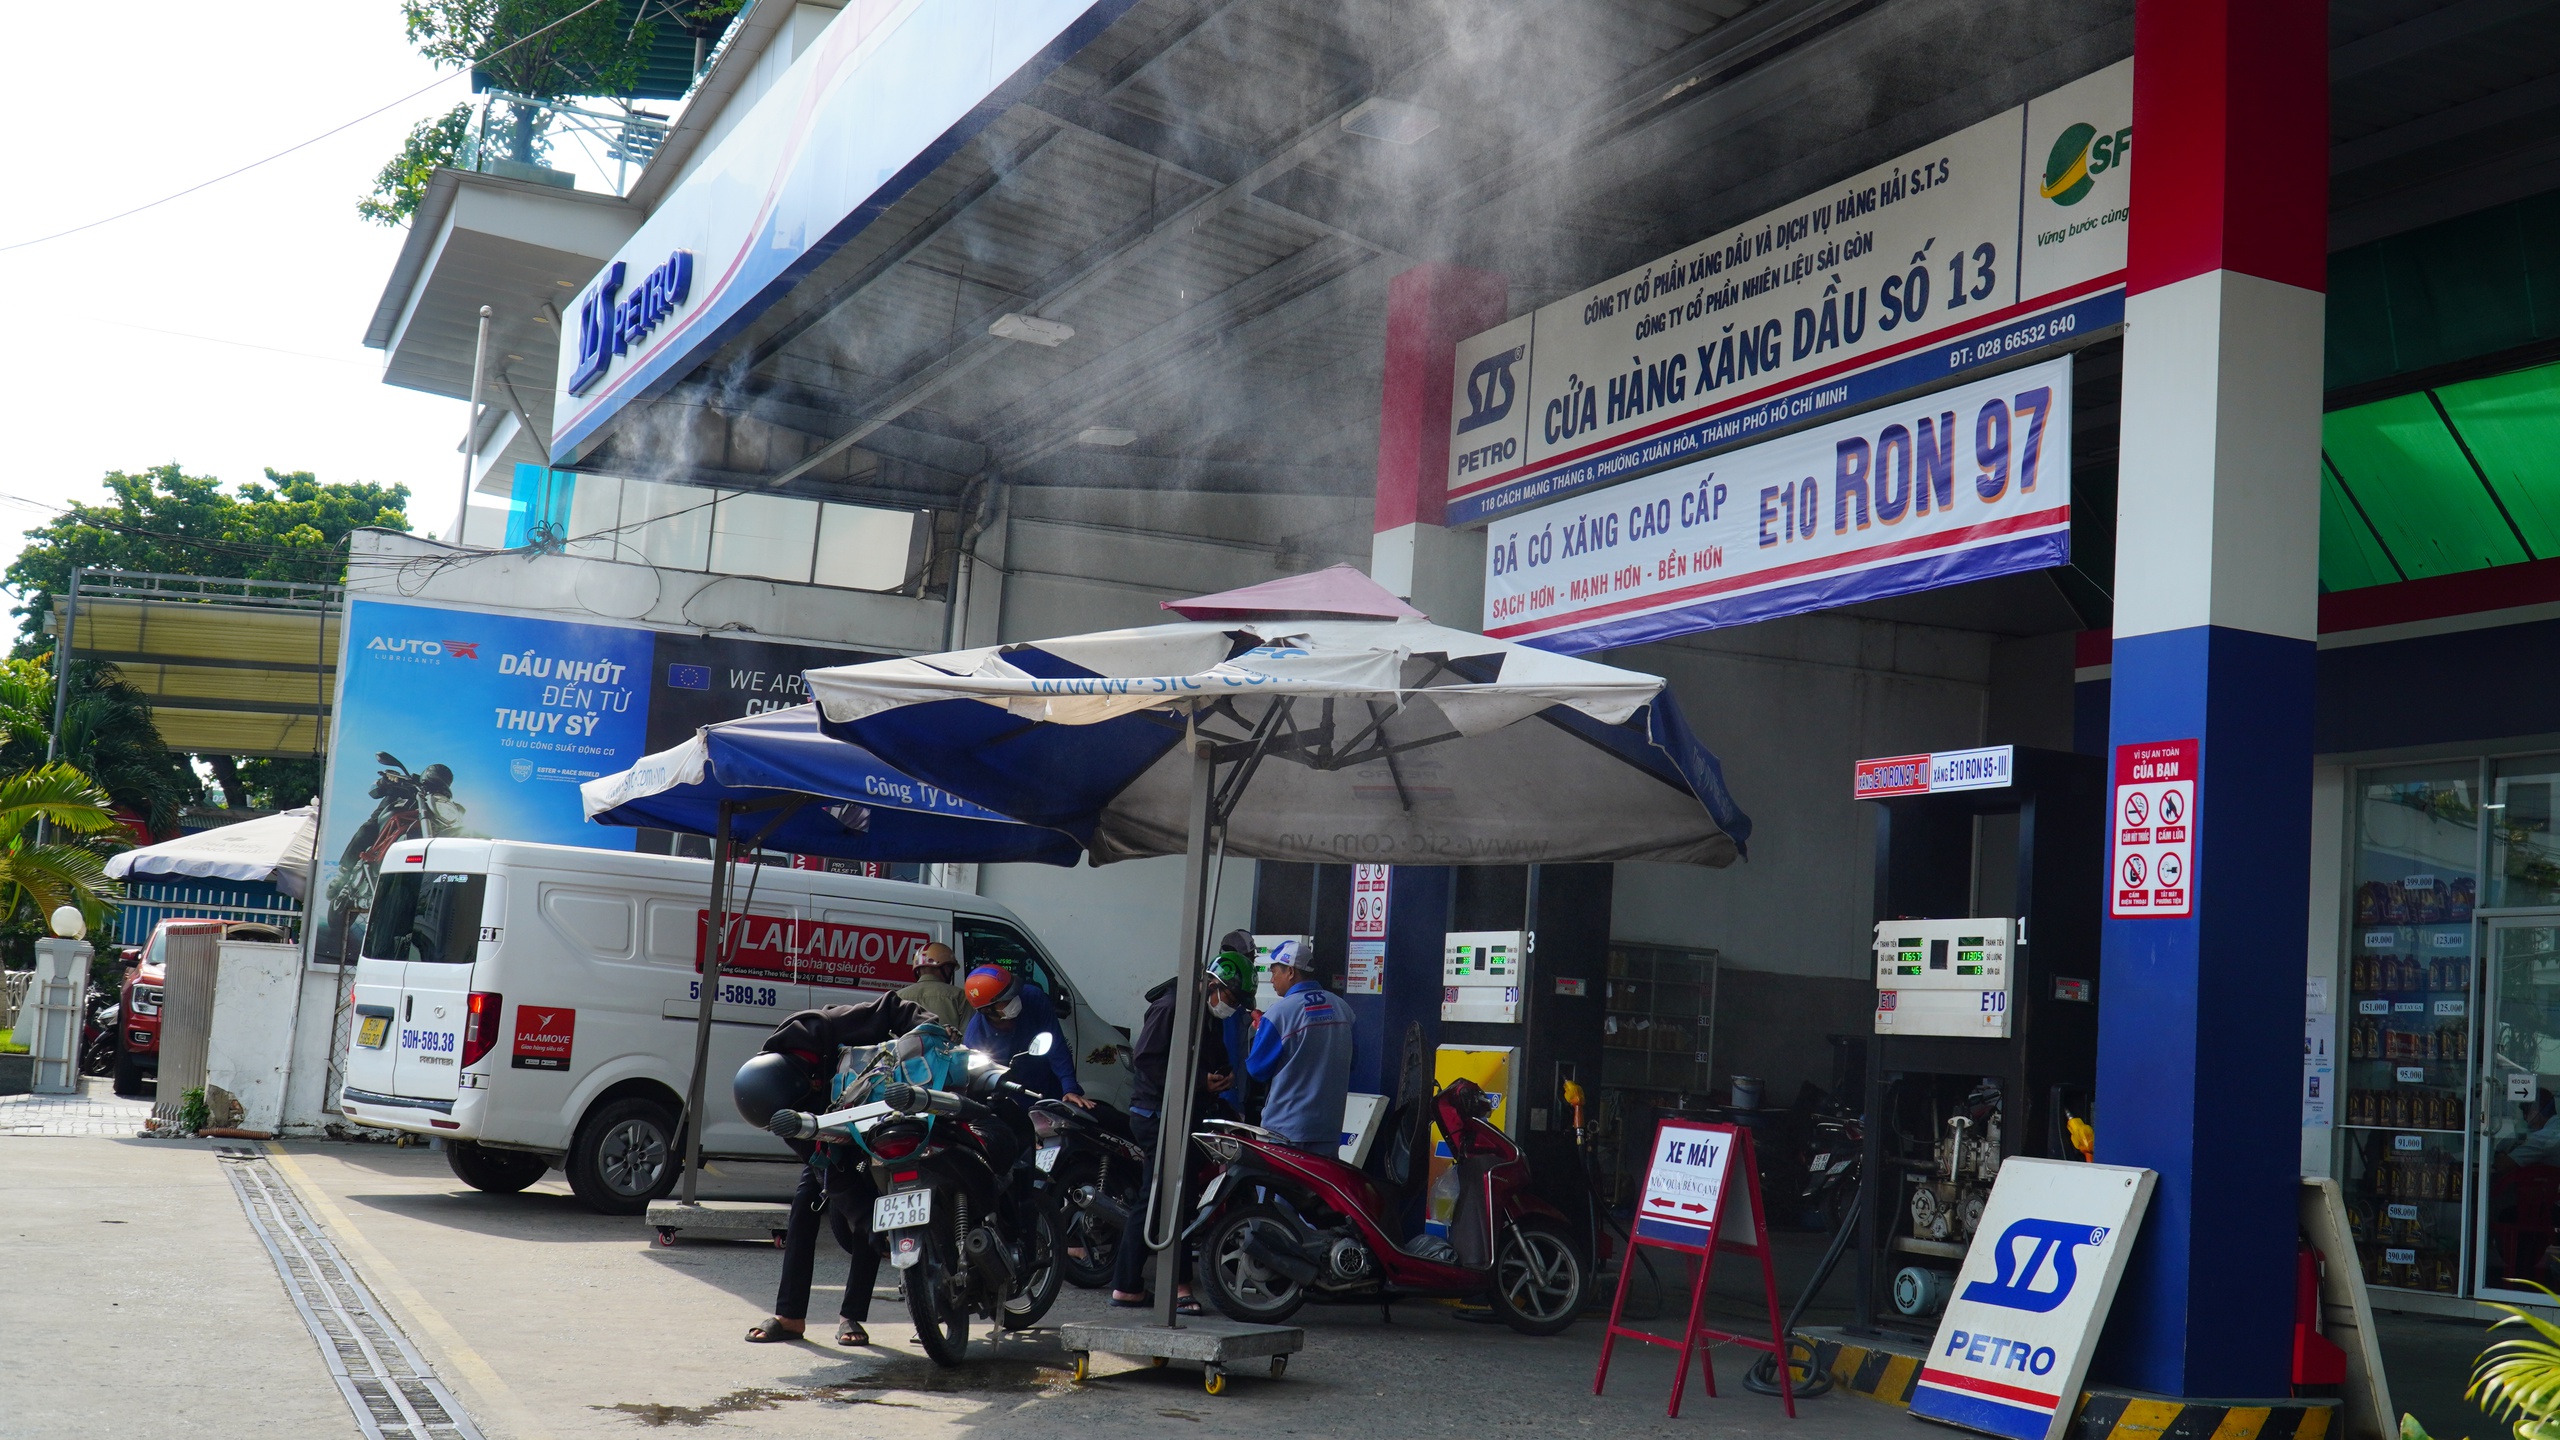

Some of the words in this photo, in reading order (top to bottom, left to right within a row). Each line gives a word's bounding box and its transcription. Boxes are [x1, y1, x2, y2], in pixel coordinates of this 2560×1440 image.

[2037, 223, 2067, 247] Vững
[2068, 217, 2099, 238] bước
[2100, 206, 2130, 228] cùng
[1584, 298, 1613, 325] CÔNG
[1617, 290, 1631, 315] TY
[1634, 268, 1653, 307] CỔ
[1653, 255, 1686, 299] PHẦN
[1688, 250, 1723, 289] XĂNG
[1725, 232, 1751, 271] DẦU
[1755, 226, 1773, 256] VÀ
[1777, 214, 1808, 252] DỊCH
[1812, 204, 1831, 236] VỤ
[1835, 187, 1876, 225] HÀNG
[1880, 167, 1907, 208] HẢI
[1910, 157, 1950, 195] S.T.S
[1635, 310, 1666, 341] CÔNG
[1669, 302, 1683, 326] TY
[1686, 288, 1705, 322] CỔ
[1706, 278, 1739, 315] PHẦN
[1742, 267, 1781, 299] NHIÊN
[1783, 255, 1814, 286] LIỆU
[1816, 240, 1840, 271] SÀI
[1844, 231, 1873, 262] GÒN
[612, 248, 693, 357] PETRO
[1544, 373, 1597, 446] CỬA
[1607, 353, 1687, 426] HÀNG
[1694, 318, 1783, 397] XĂNG
[1791, 273, 1868, 362] DẦU
[1878, 237, 1936, 332] SỐ
[1947, 241, 1997, 311] 13
[1950, 349, 1974, 370] ĐT:
[1976, 339, 2001, 361] 028
[2004, 324, 2046, 352] 66532
[2049, 313, 2076, 338] 640
[1457, 437, 1517, 476] PETRO
[1481, 498, 1495, 512] 118
[1496, 485, 1522, 508] CÁCH
[1523, 478, 1550, 502] MẠNG
[1552, 467, 1585, 491] THÁNG
[1586, 464, 1596, 485] 8,
[1597, 451, 1640, 477] PHƯỜNG
[1642, 438, 1671, 465] XUÂN
[1673, 430, 1699, 454] HÒA,
[1702, 418, 1740, 444] THÀNH
[1743, 403, 1768, 433] PHỐ
[1770, 398, 1789, 425] HỒ
[1791, 390, 1813, 417] CHÍ
[1815, 385, 1848, 412] MINH
[1493, 532, 1519, 577] ĐÃ
[1528, 522, 1552, 568] CÓ
[1562, 512, 1618, 560] XĂNG
[1629, 498, 1671, 546] CAO
[1681, 472, 1728, 529] CẤP
[1759, 476, 1818, 549] E10
[1834, 410, 1956, 536] RON
[1975, 385, 2053, 504] 97
[1493, 592, 1525, 620] SẠCH
[1530, 581, 1556, 608] HƠN
[1570, 573, 1608, 602] MẠNH
[1614, 564, 1641, 591] HƠN
[1658, 548, 1687, 581] BỀN
[1693, 545, 1723, 573] HƠN
[375, 653, 441, 666] LUBRICANTS
[498, 649, 552, 678] DẦU
[555, 658, 626, 686] NHỚT
[730, 669, 766, 691] WE
[541, 681, 593, 710] ĐẾN
[600, 687, 632, 713] TỪ
[494, 707, 564, 737] THỤY
[564, 711, 600, 737] SỸ
[501, 738, 515, 748] TỐI
[516, 739, 529, 749] ƯU
[530, 741, 553, 751] CÔNG
[555, 742, 577, 753] SUẤT
[578, 745, 601, 756] ĐỘNG
[603, 748, 615, 757] CƠ
[2134, 751, 2141, 760] VÌ
[2141, 750, 2151, 759] SỰ
[2151, 749, 2161, 758] AN
[2162, 747, 2180, 757] TOÀN
[578, 770, 600, 778] SHIELD
[1858, 772, 1872, 790] XĂNG
[1873, 767, 1887, 789] E10
[1888, 764, 1904, 788] RON
[1934, 766, 1948, 783] XĂNG
[1950, 760, 1965, 781] E10
[1966, 758, 1982, 780] RON
[2133, 760, 2154, 779] CỦA
[2156, 762, 2179, 780] BẠN
[865, 775, 913, 804] Công
[917, 781, 938, 807] Ty
[2158, 828, 2171, 840] CẤM
[2172, 828, 2184, 840] LỬA
[2406, 878, 2432, 886] 399.000
[2017, 917, 2027, 945] 1
[2367, 936, 2392, 944] 149.000
[2436, 936, 2461, 944] 123.000
[739, 920, 928, 966] LALAMOVE
[1527, 931, 1535, 953] 3
[783, 955, 809, 968] Giao
[810, 957, 836, 972] hàng
[837, 960, 857, 972] siêu
[858, 961, 876, 975] tốc
[689, 981, 776, 1007] 5-589.38
[1446, 988, 1458, 1002] E10
[1505, 987, 1518, 1002] E10
[1881, 994, 1897, 1009] E10
[1981, 991, 2006, 1011] E10
[2361, 1003, 2386, 1011] 151.000
[2436, 1003, 2462, 1012] 125.000
[367, 1019, 381, 1031] 50H
[1699, 1017, 1709, 1025] E10
[402, 1029, 454, 1052] 50H-589.38
[518, 1033, 570, 1044] LALAMOVE
[2399, 1071, 2422, 1079] 95.000
[1666, 1141, 1686, 1164] XE
[1686, 1139, 1719, 1168] MÁY
[2398, 1139, 2420, 1148] 91.000
[884, 1193, 923, 1212] 84-K1
[2389, 1206, 2415, 1217] 508.000
[879, 1208, 926, 1228] 473.86
[2388, 1252, 2413, 1261] 390.000
[1945, 1330, 2056, 1376] PETRO
